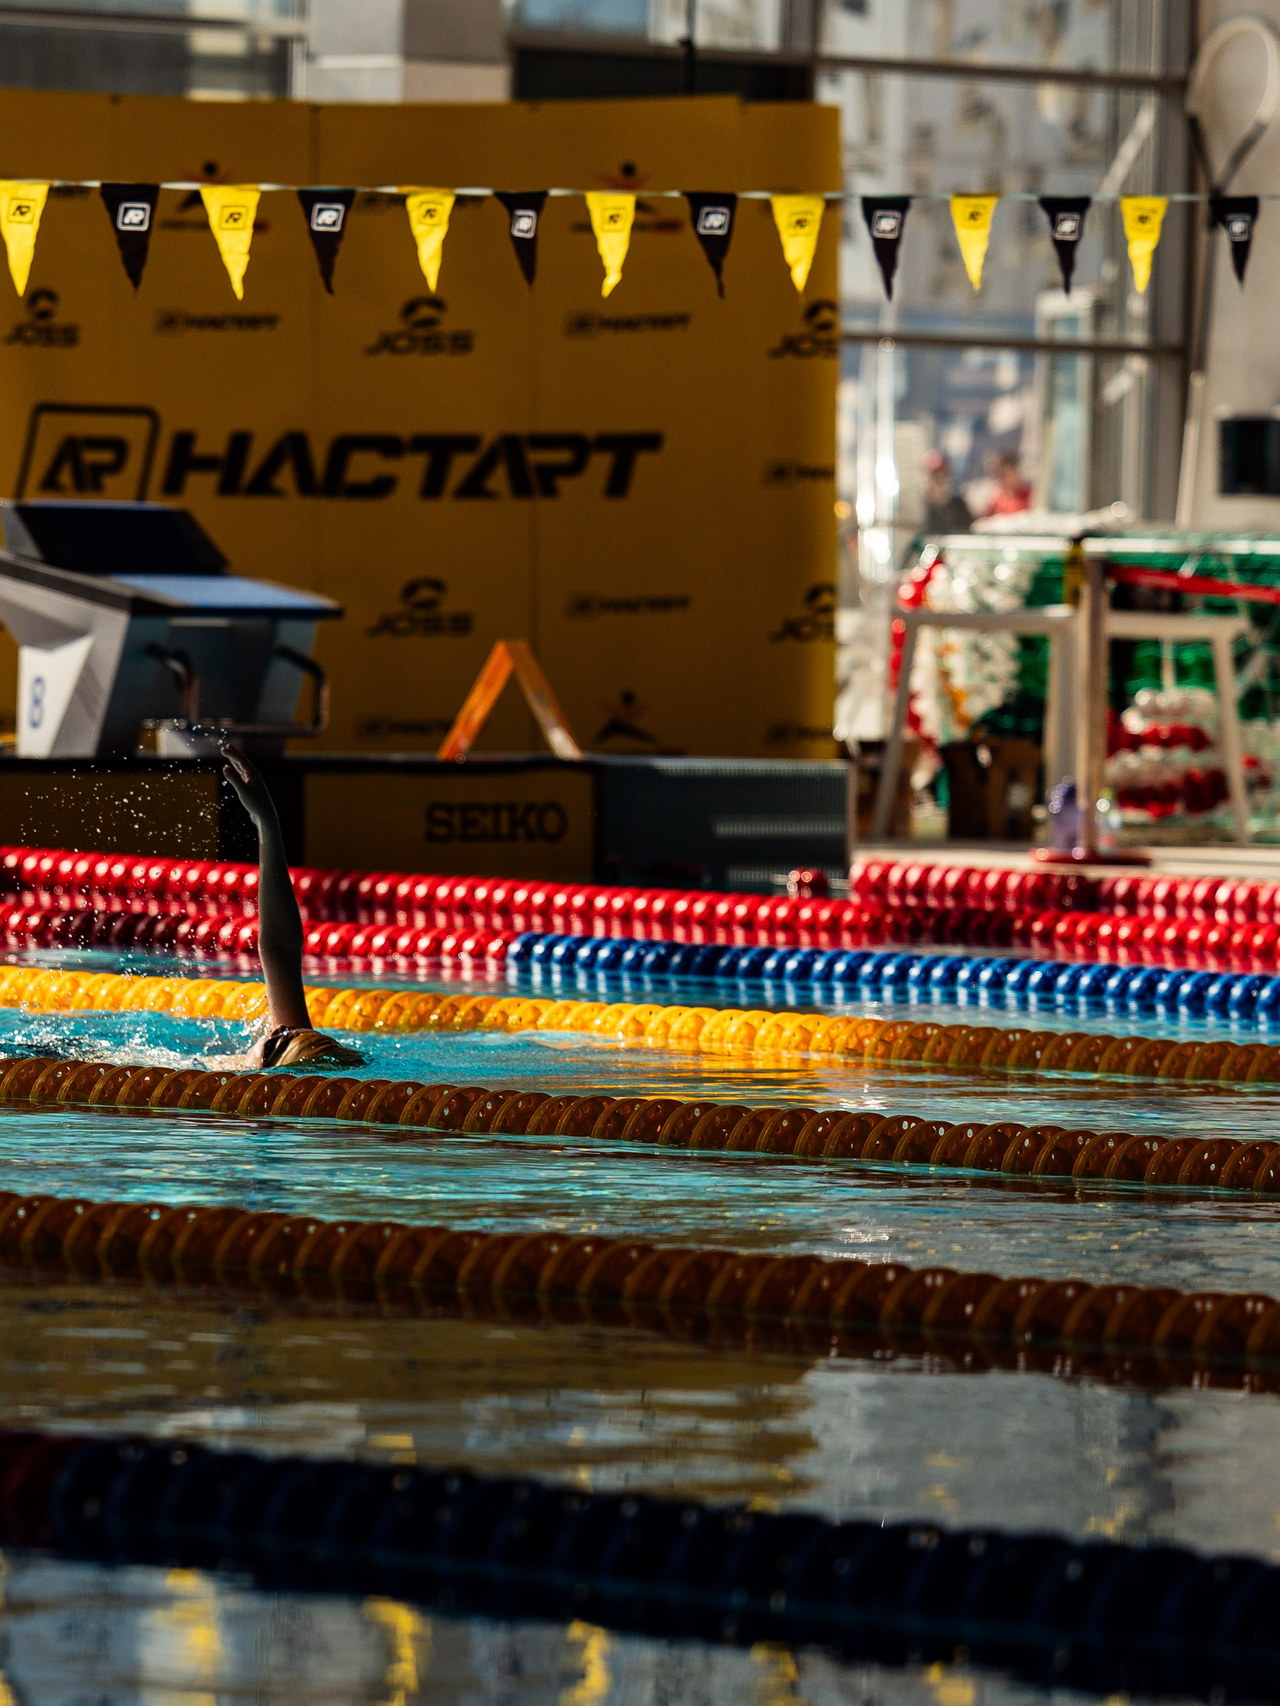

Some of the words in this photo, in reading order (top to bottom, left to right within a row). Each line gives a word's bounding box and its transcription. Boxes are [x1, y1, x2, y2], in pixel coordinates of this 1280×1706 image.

[4, 323, 81, 348] JOSS
[365, 329, 475, 356] JOSS
[162, 429, 665, 499] НАСТАРТ
[366, 610, 475, 637] JOSS
[30, 676, 46, 729] 8
[424, 802, 568, 845] SEIKO
